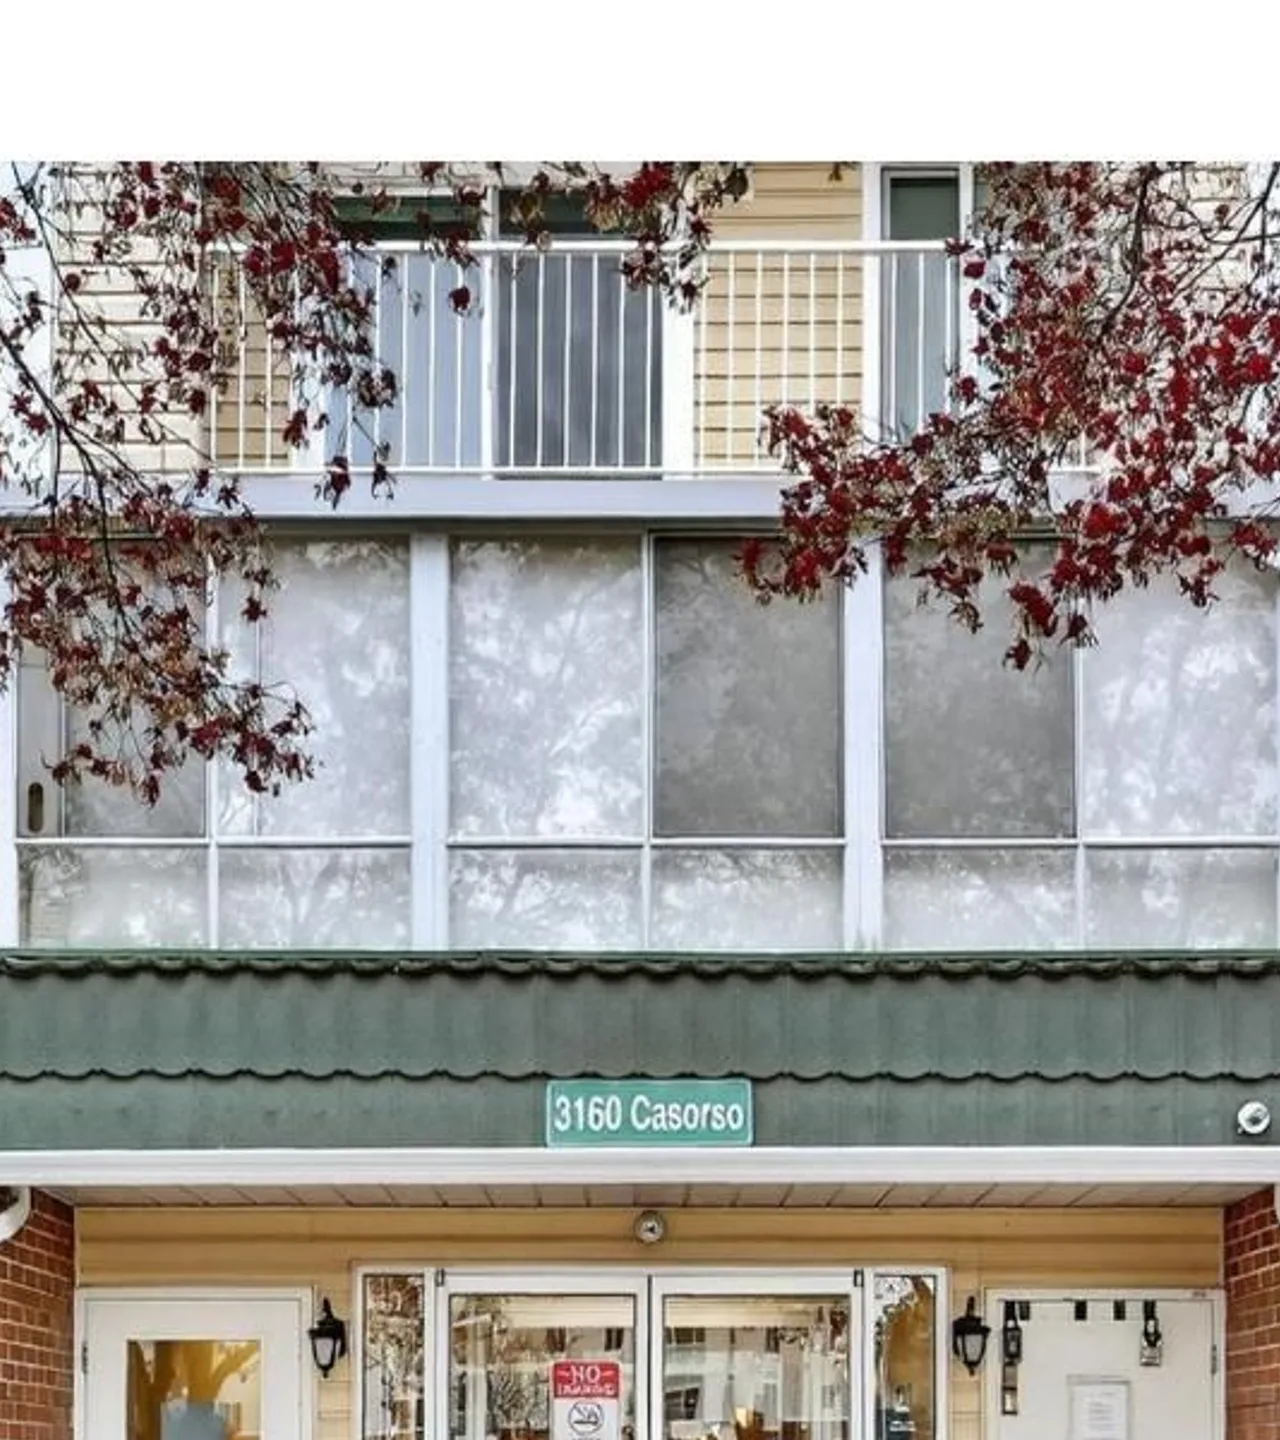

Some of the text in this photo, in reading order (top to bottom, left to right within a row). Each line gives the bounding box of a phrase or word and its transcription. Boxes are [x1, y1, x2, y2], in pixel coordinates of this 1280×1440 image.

[554, 1094, 745, 1132] 3160 Casorso
[569, 1364, 601, 1385] NO
